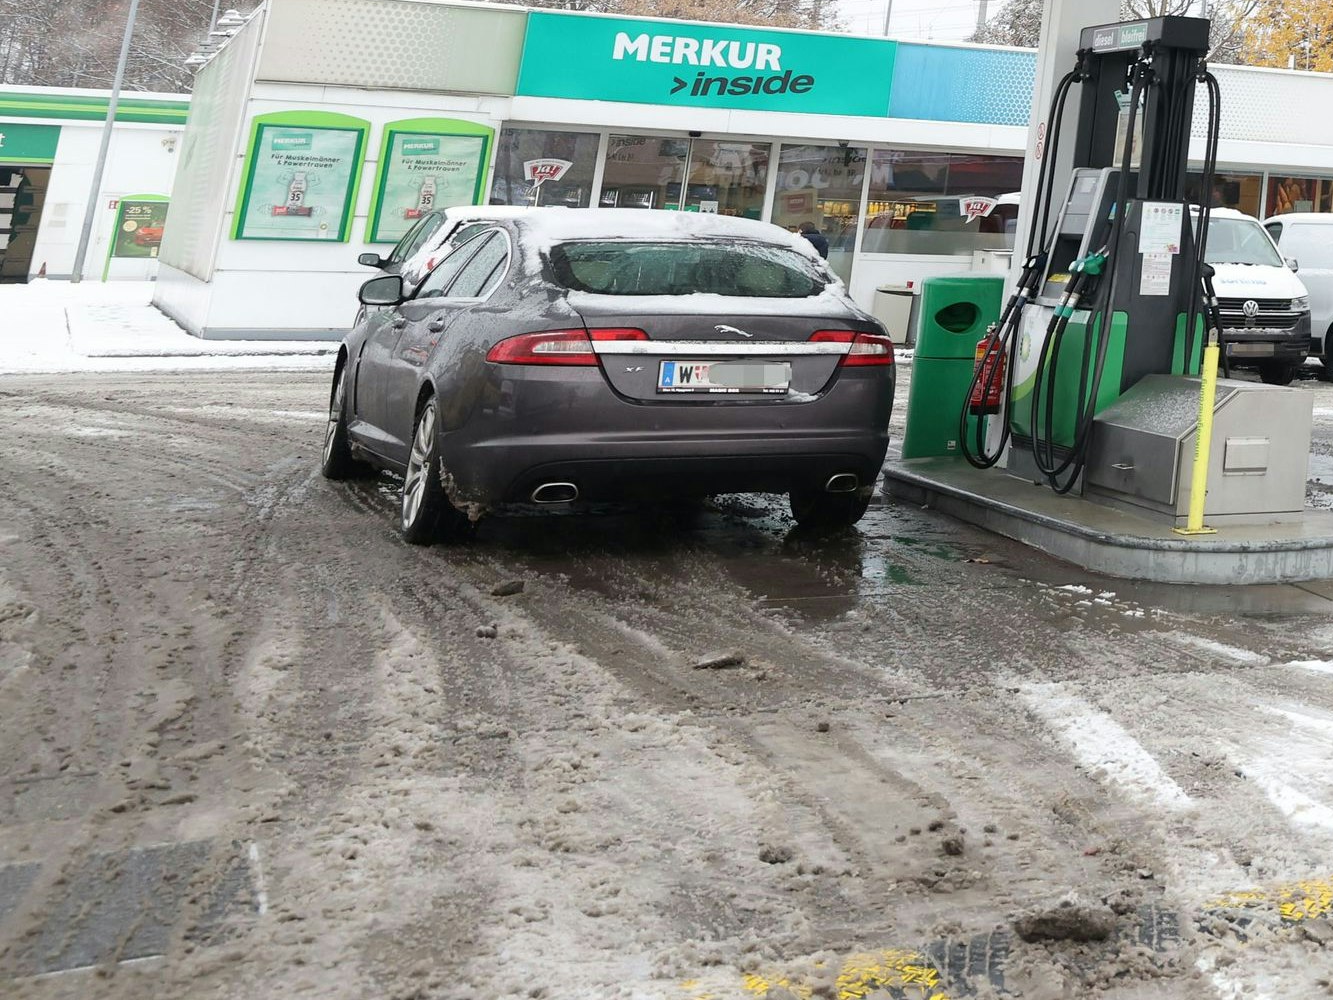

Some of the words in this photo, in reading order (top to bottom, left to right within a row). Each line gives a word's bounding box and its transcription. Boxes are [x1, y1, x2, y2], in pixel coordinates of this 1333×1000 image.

[1094, 31, 1115, 47] diesel
[612, 31, 782, 72] MERKUR
[285, 154, 341, 163] Muskelmänner
[283, 160, 334, 168] Powerfrauen
[290, 192, 301, 202] 35
[421, 196, 432, 205] 35
[679, 365, 694, 384] W
